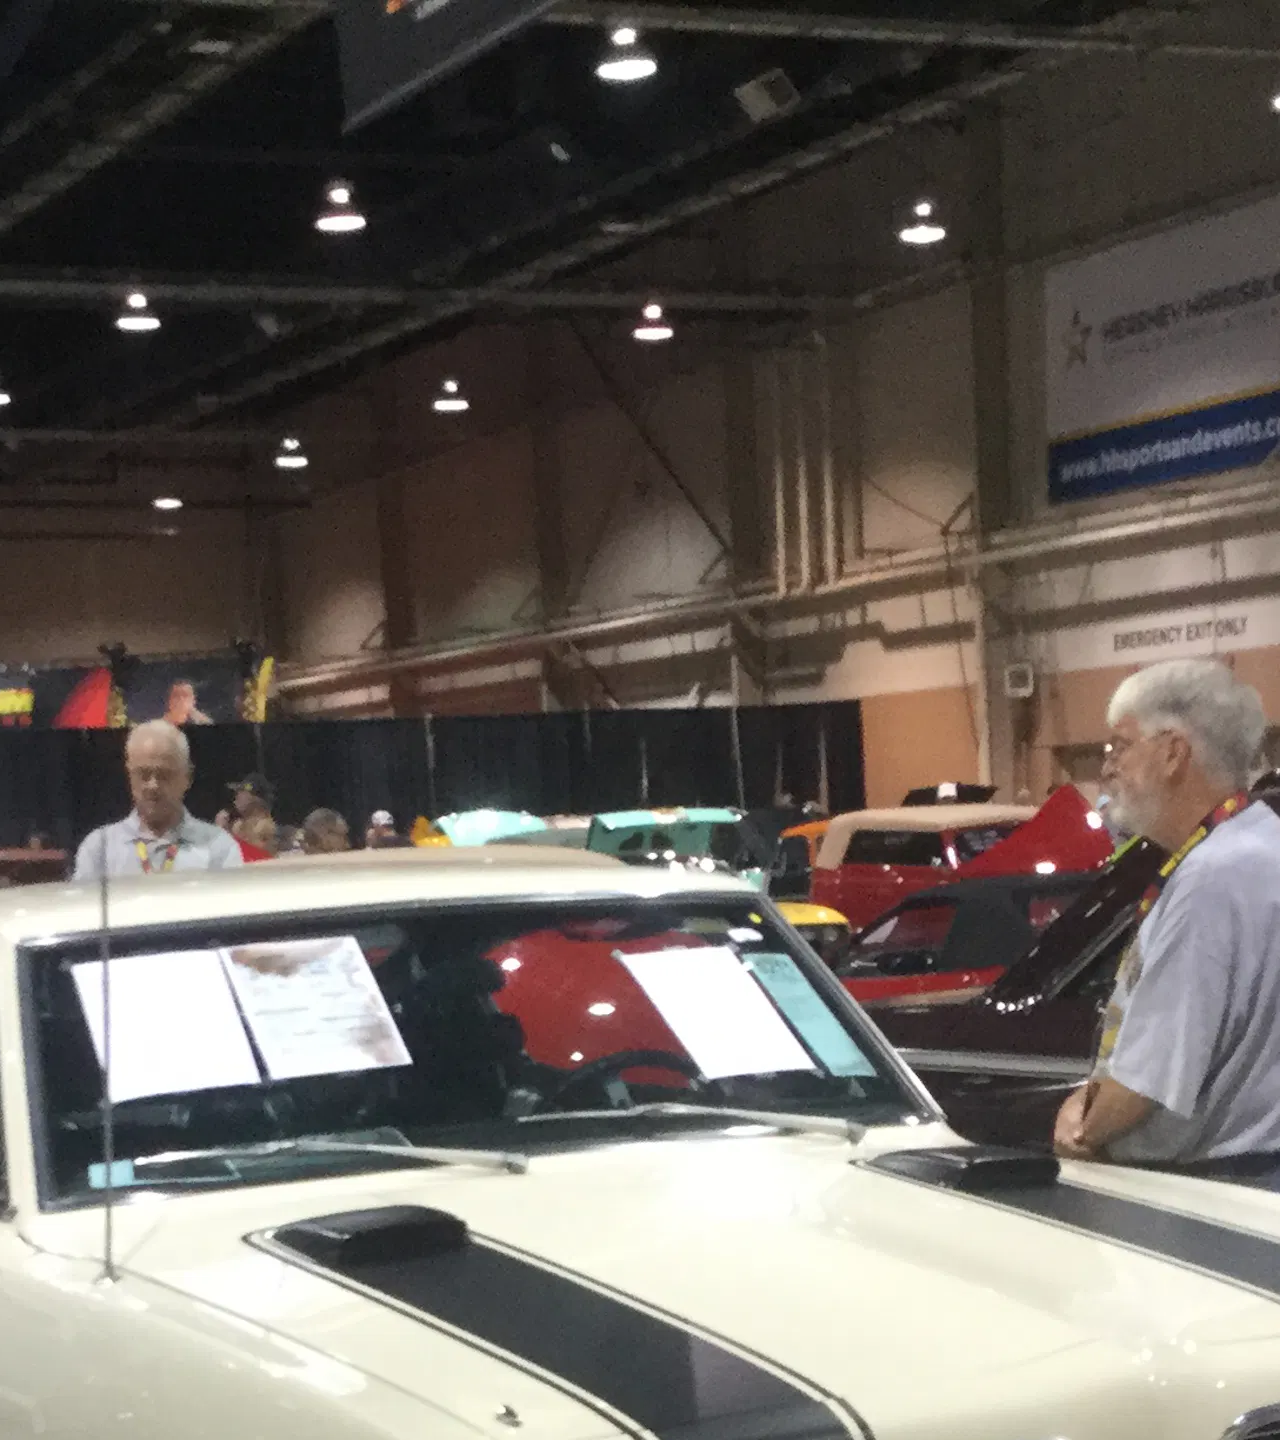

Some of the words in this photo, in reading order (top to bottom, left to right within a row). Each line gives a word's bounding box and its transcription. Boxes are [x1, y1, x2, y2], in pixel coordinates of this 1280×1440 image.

[1113, 625, 1183, 651] EMERGENCY
[1186, 620, 1212, 641] EXIT
[1215, 615, 1249, 637] ONLY
